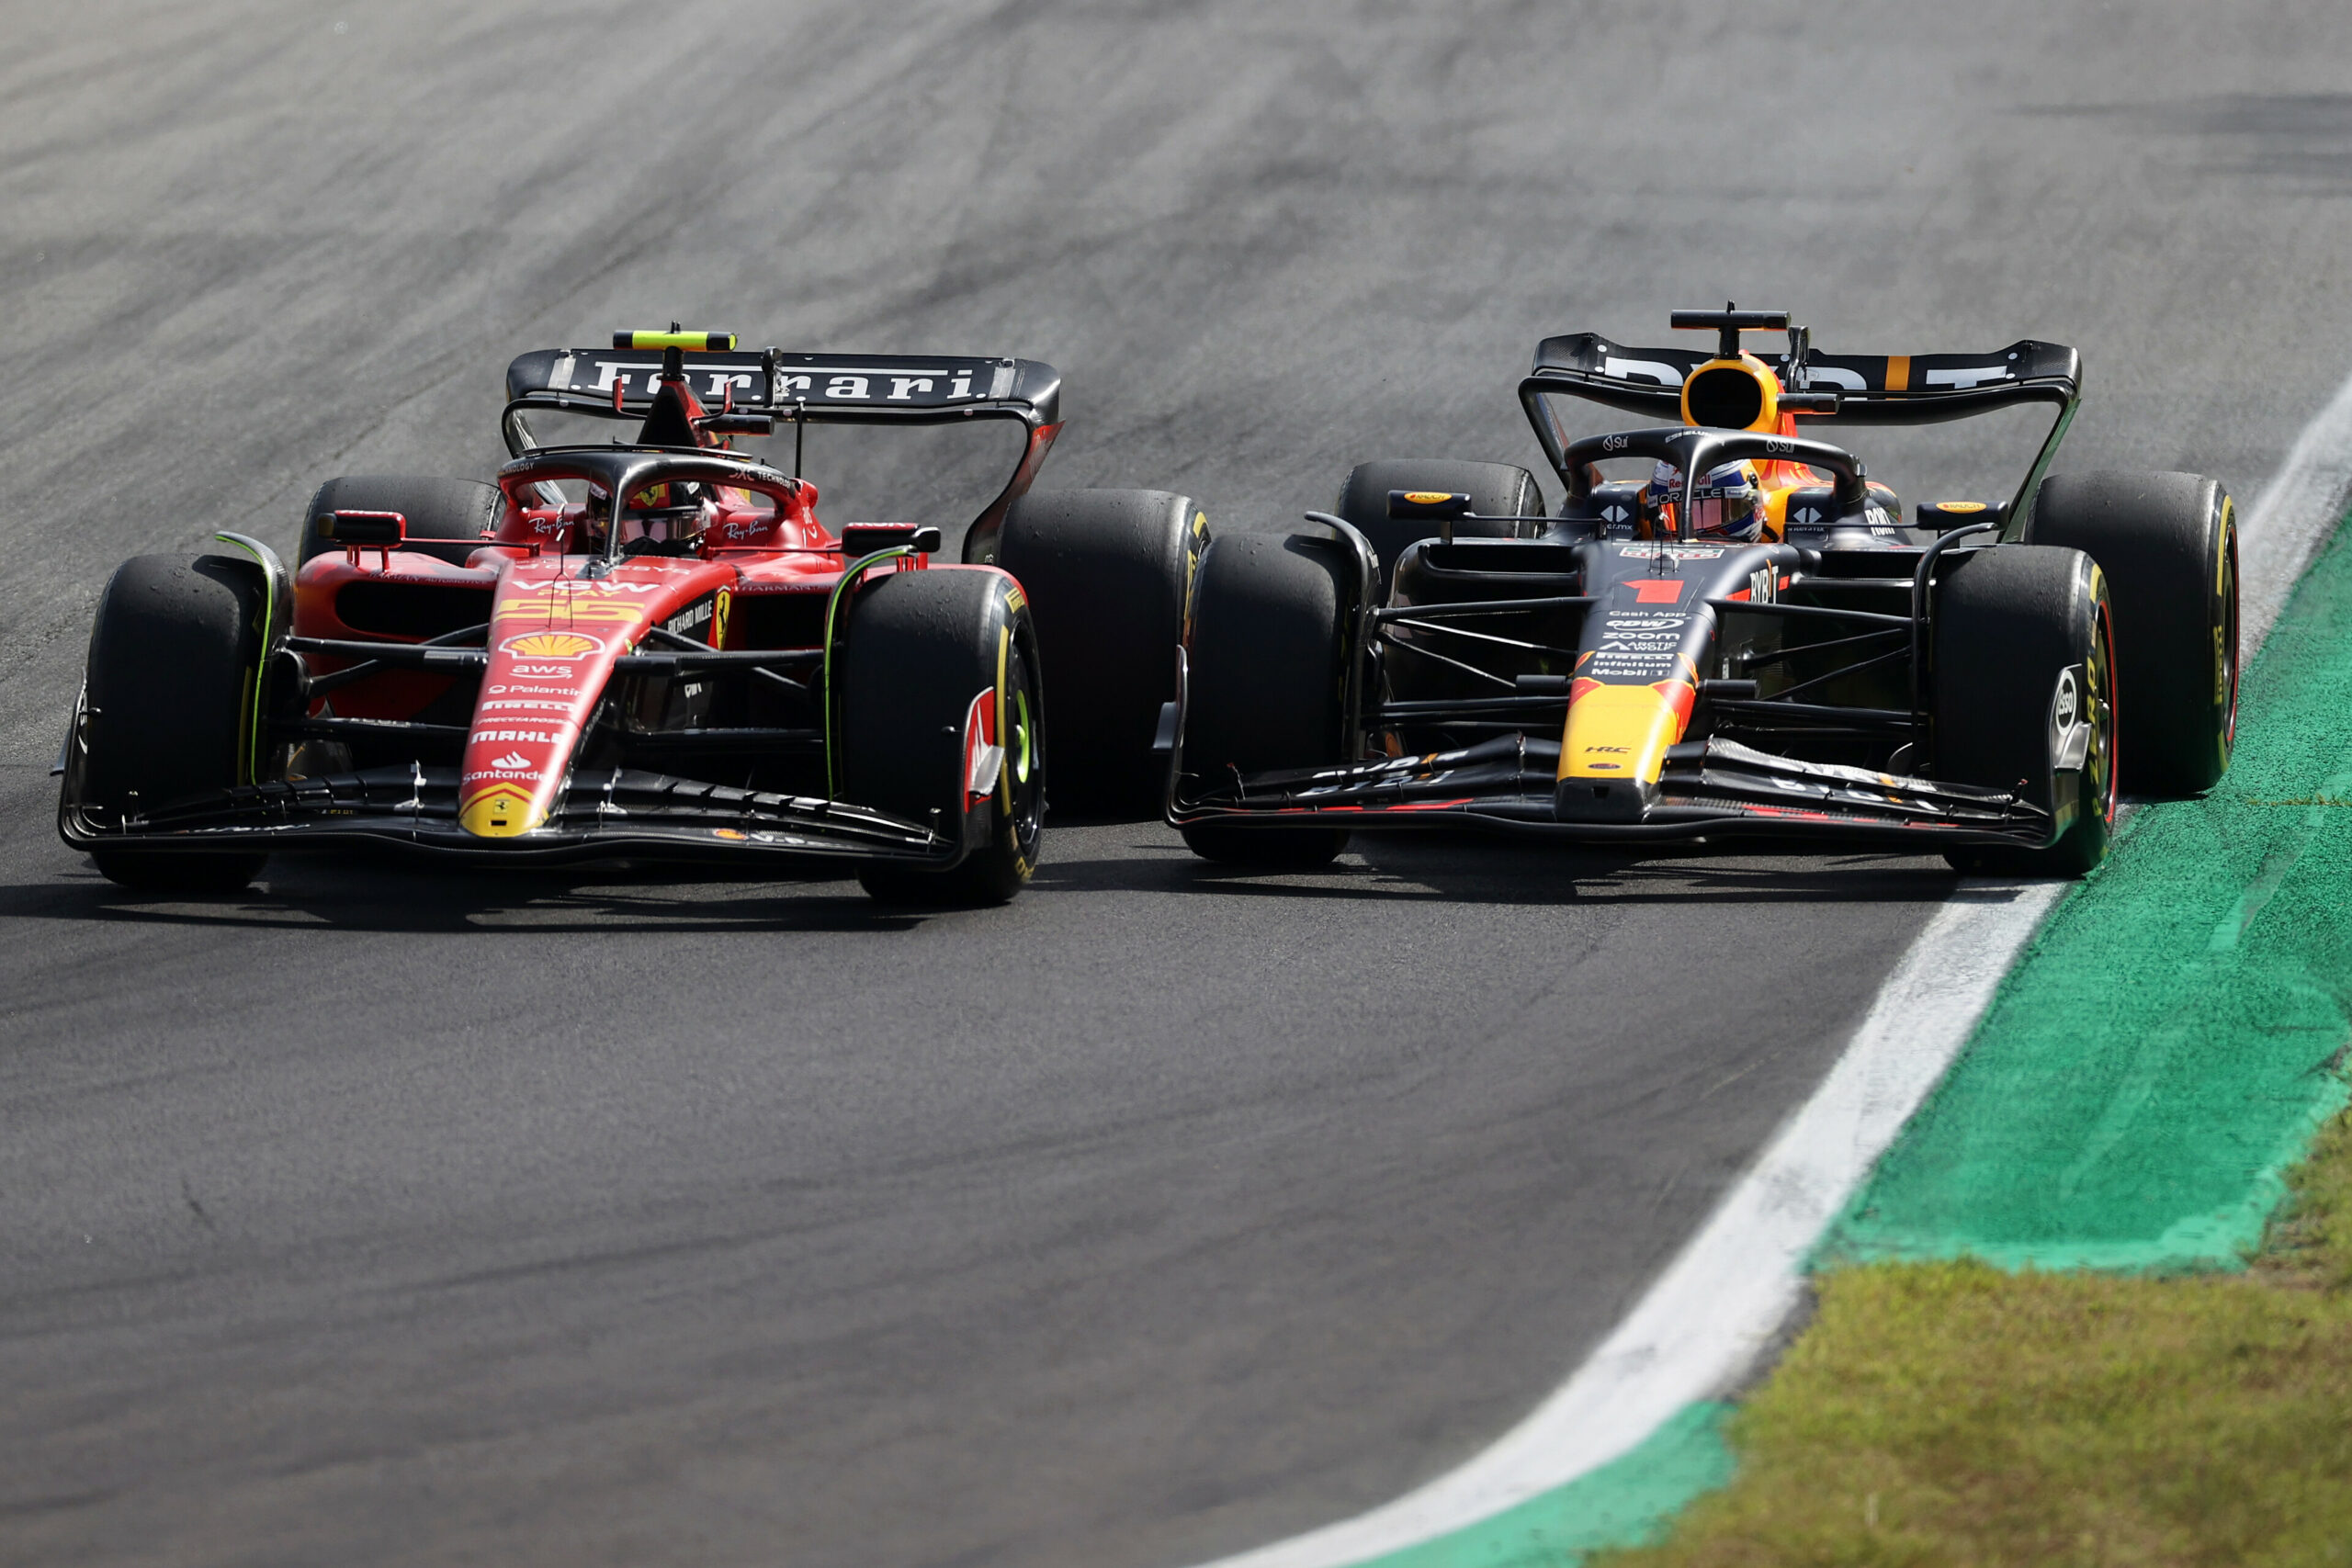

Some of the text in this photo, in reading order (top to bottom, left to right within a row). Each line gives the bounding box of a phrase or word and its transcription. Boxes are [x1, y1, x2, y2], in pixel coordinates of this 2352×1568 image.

[528, 517, 575, 534] Ray-Ban
[723, 521, 769, 540] Ray-Ban
[512, 581, 661, 593] VGW
[1749, 558, 1779, 604] BYBIT
[537, 590, 622, 598] PLAY
[1622, 579, 1685, 604] 1
[493, 599, 646, 625] 55
[668, 600, 713, 634] RICHARD MILLE
[1602, 632, 1681, 640] zoom
[1596, 651, 1675, 660] PIRELLI
[511, 665, 572, 674] aws
[1591, 668, 1648, 676] Mobil
[510, 685, 582, 696] Palantir
[481, 699, 577, 713] PIRELLI
[470, 730, 566, 745] MAHLE
[1585, 746, 1632, 754] HRC
